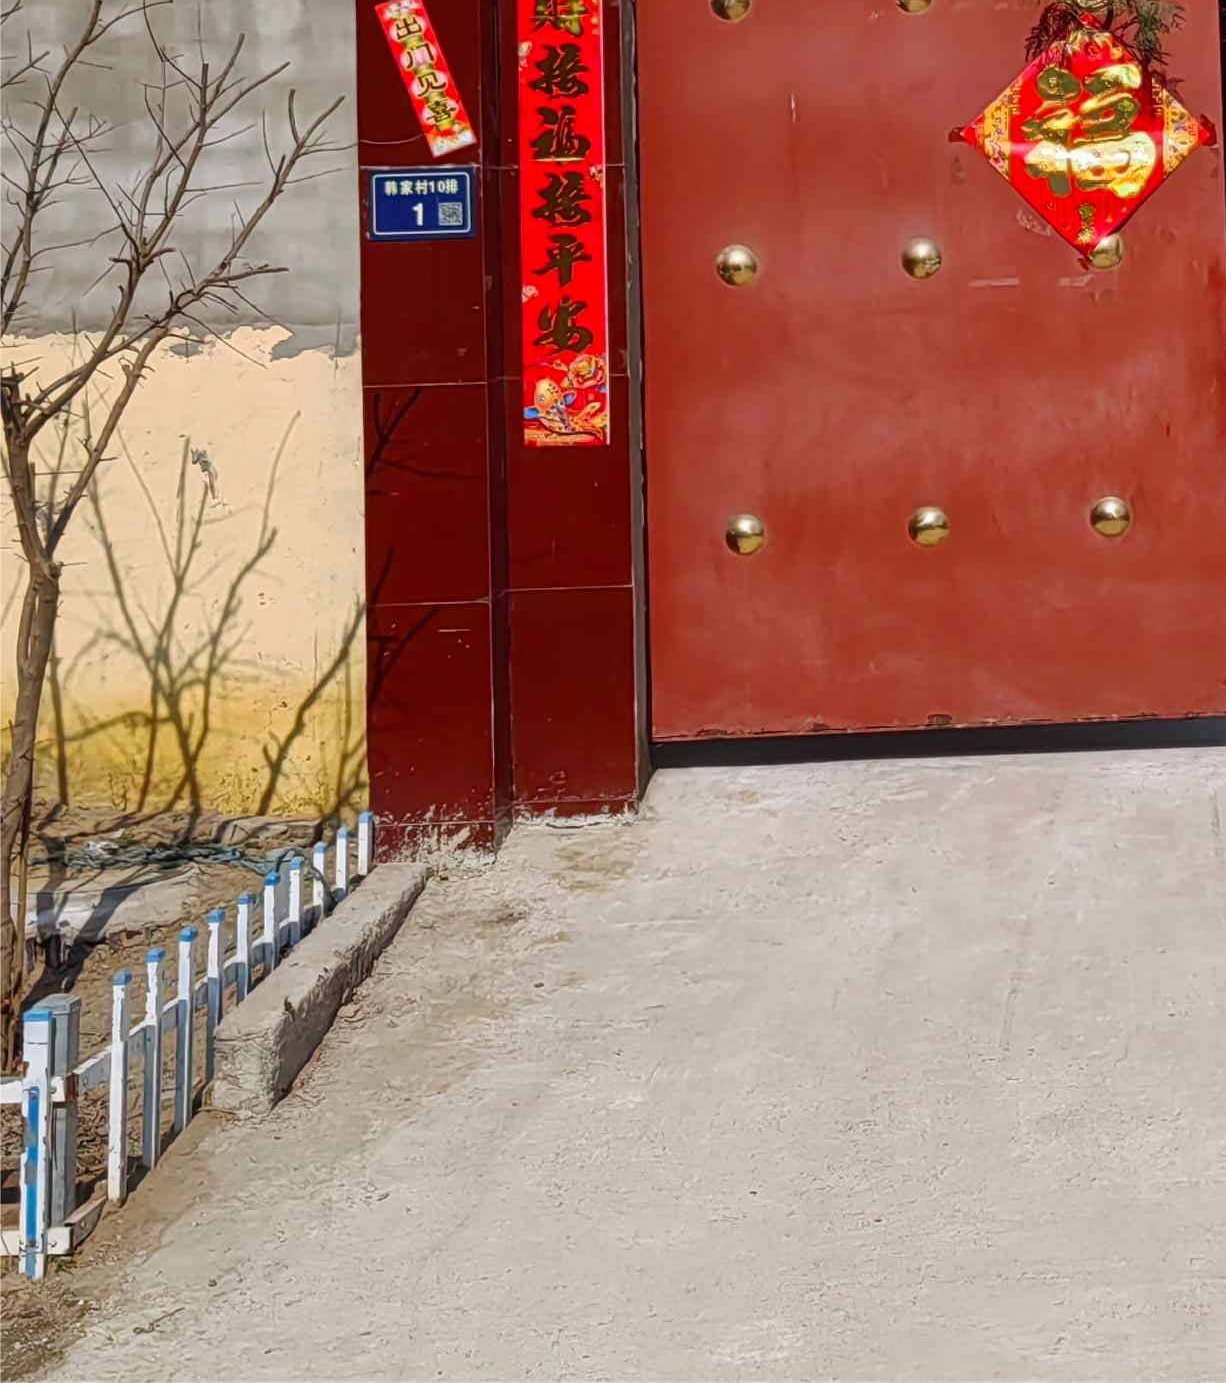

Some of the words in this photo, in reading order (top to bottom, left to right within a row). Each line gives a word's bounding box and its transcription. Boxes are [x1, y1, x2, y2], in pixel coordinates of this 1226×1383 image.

[395, 16, 456, 123] 出门见喜
[1023, 62, 1156, 198] 福
[412, 202, 424, 226] 1
